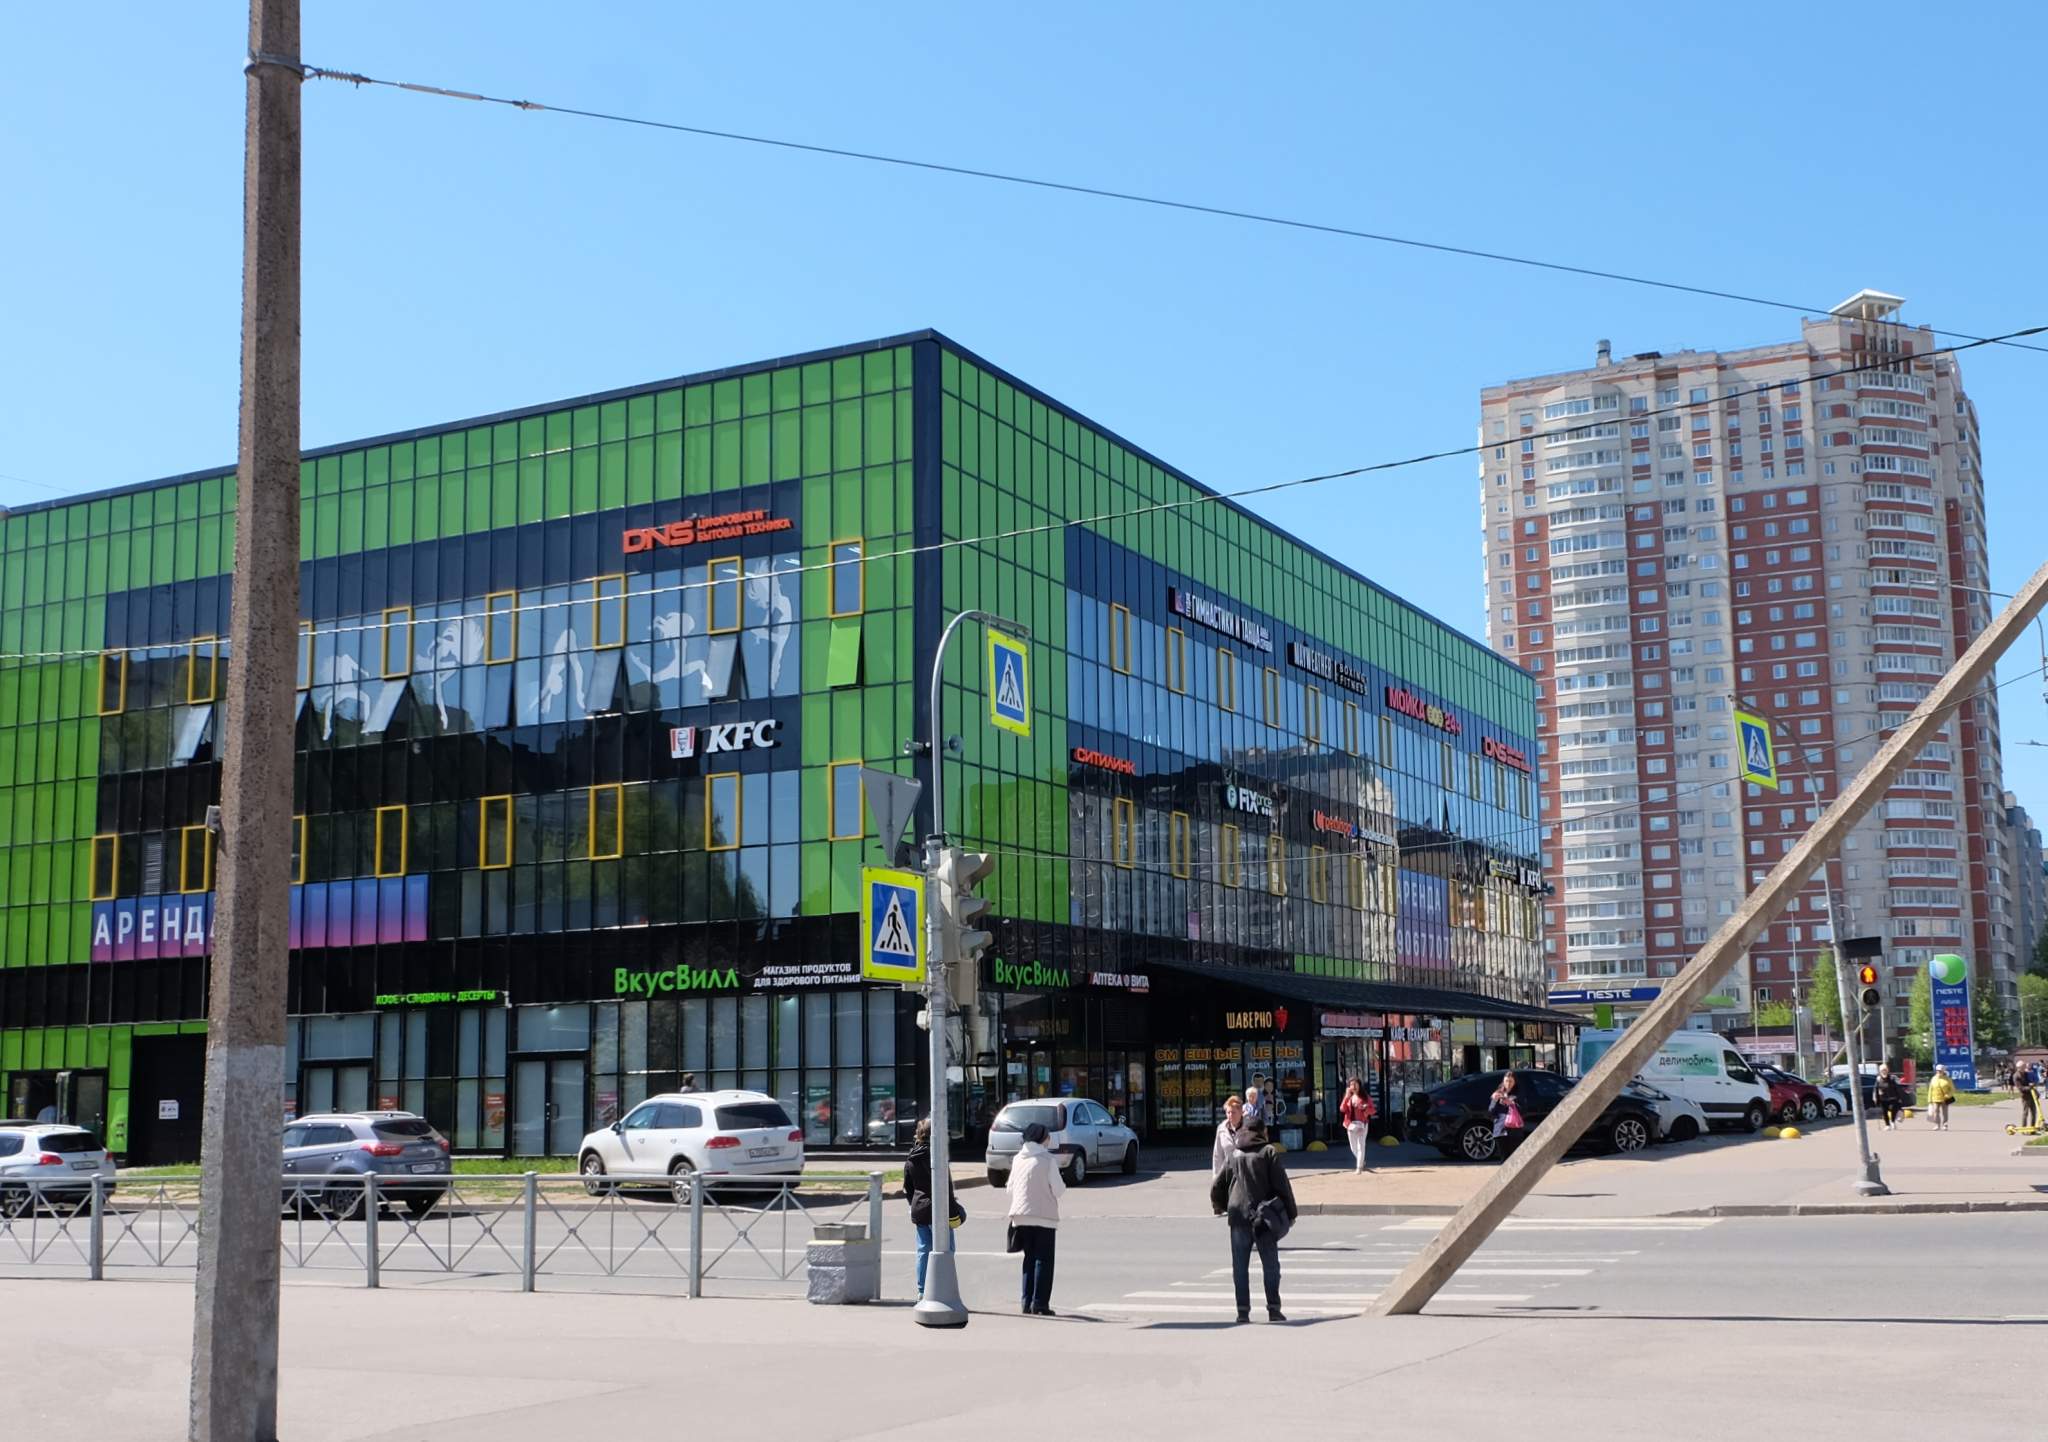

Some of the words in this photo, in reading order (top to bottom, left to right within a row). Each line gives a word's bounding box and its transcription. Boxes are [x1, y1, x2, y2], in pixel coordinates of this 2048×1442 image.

[623, 520, 695, 553] DNS
[697, 525, 743, 542] БЫТОВАЯ
[745, 518, 791, 535] ТЕХНИКА
[1192, 594, 1235, 636] ГИМНАСТИКИ
[1241, 617, 1260, 649] ТАНЦА
[1339, 663, 1368, 684] BOXING
[1340, 675, 1368, 696] FITNESS
[1388, 686, 1425, 721] МОЙКА
[706, 719, 776, 753] KFC
[1484, 736, 1507, 762] DNS
[1075, 748, 1136, 775] СИТИЛИНК
[1397, 879, 1441, 914] АРЕНДА
[94, 906, 217, 946] АРЕНД
[1396, 929, 1449, 961] 9067707
[614, 964, 740, 998] ВкусВилл
[753, 977, 772, 988] ДЛЯ
[773, 974, 820, 987] ЗДОРОВОГО
[821, 973, 861, 985] ПИТАНИЯ
[763, 965, 800, 976] МАГАЗИН
[801, 962, 851, 975] ПРОДУКТОВ
[994, 957, 1070, 990] ВкусВилл
[1092, 971, 1123, 988] АПТЕКА
[1226, 1011, 1272, 1029] ШАВЕРНО
